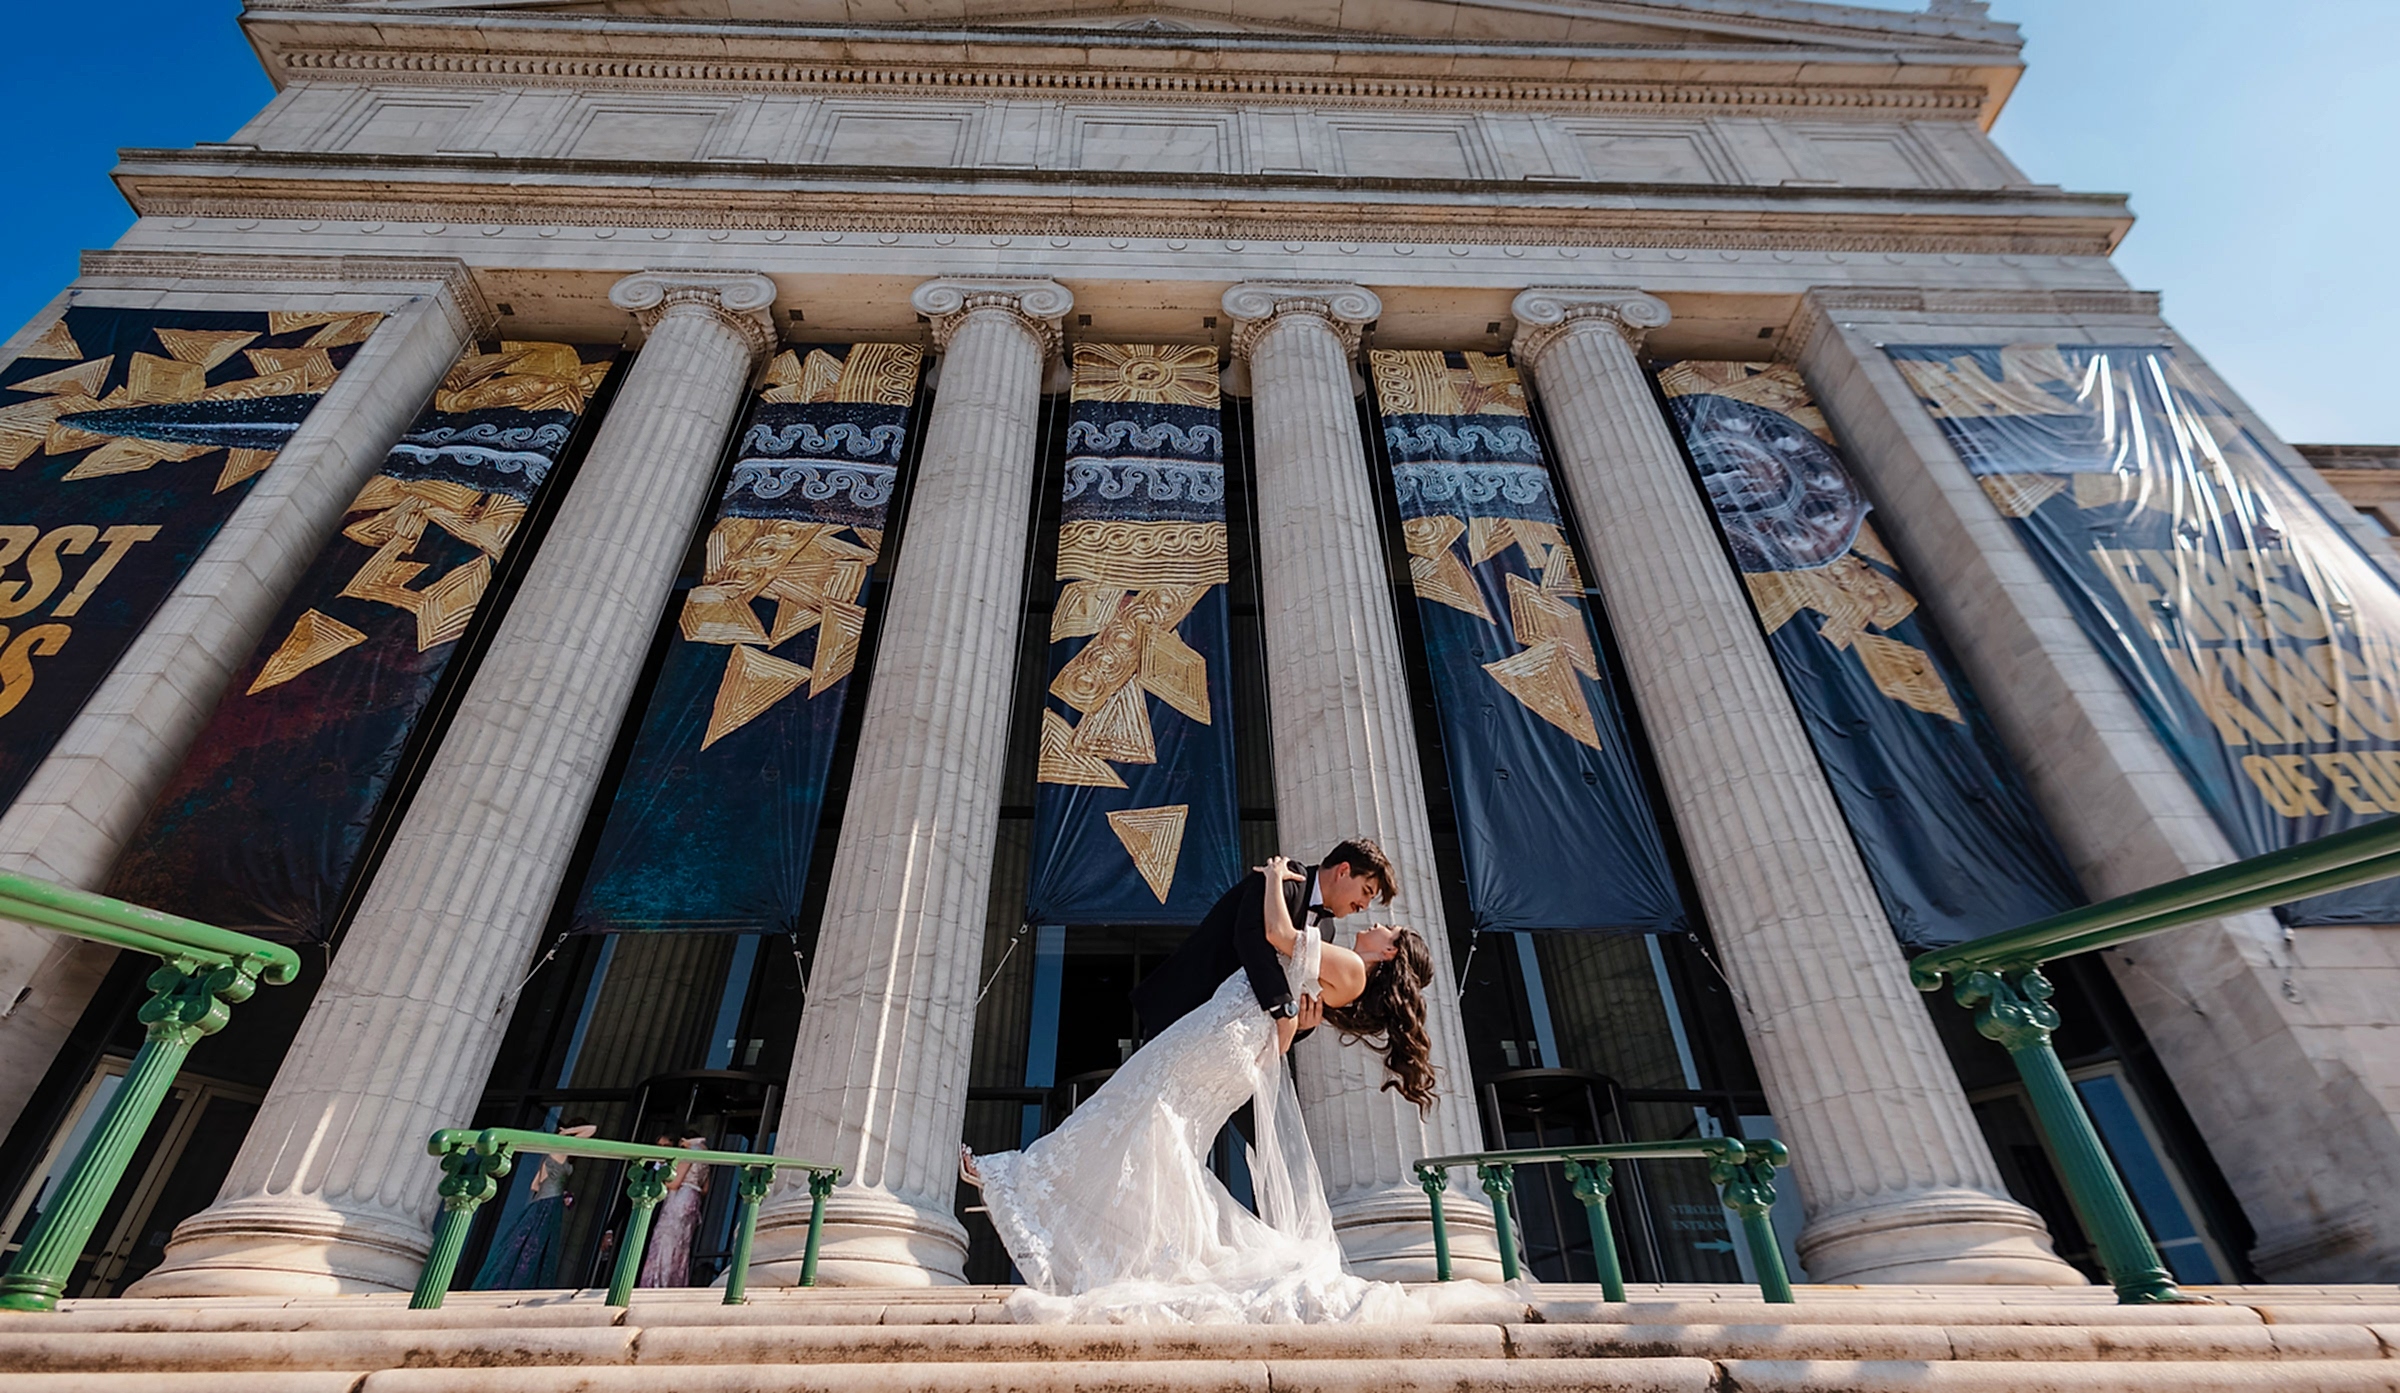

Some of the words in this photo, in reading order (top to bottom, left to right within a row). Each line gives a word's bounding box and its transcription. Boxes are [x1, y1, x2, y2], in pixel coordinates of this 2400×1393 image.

[2089, 549, 2362, 640] FIRS
[0, 623, 72, 718] S
[2167, 645, 2400, 744] KING
[2241, 754, 2330, 817] OF
[2310, 751, 2400, 814] EU
[1671, 1220, 1726, 1230] ENTRAN
